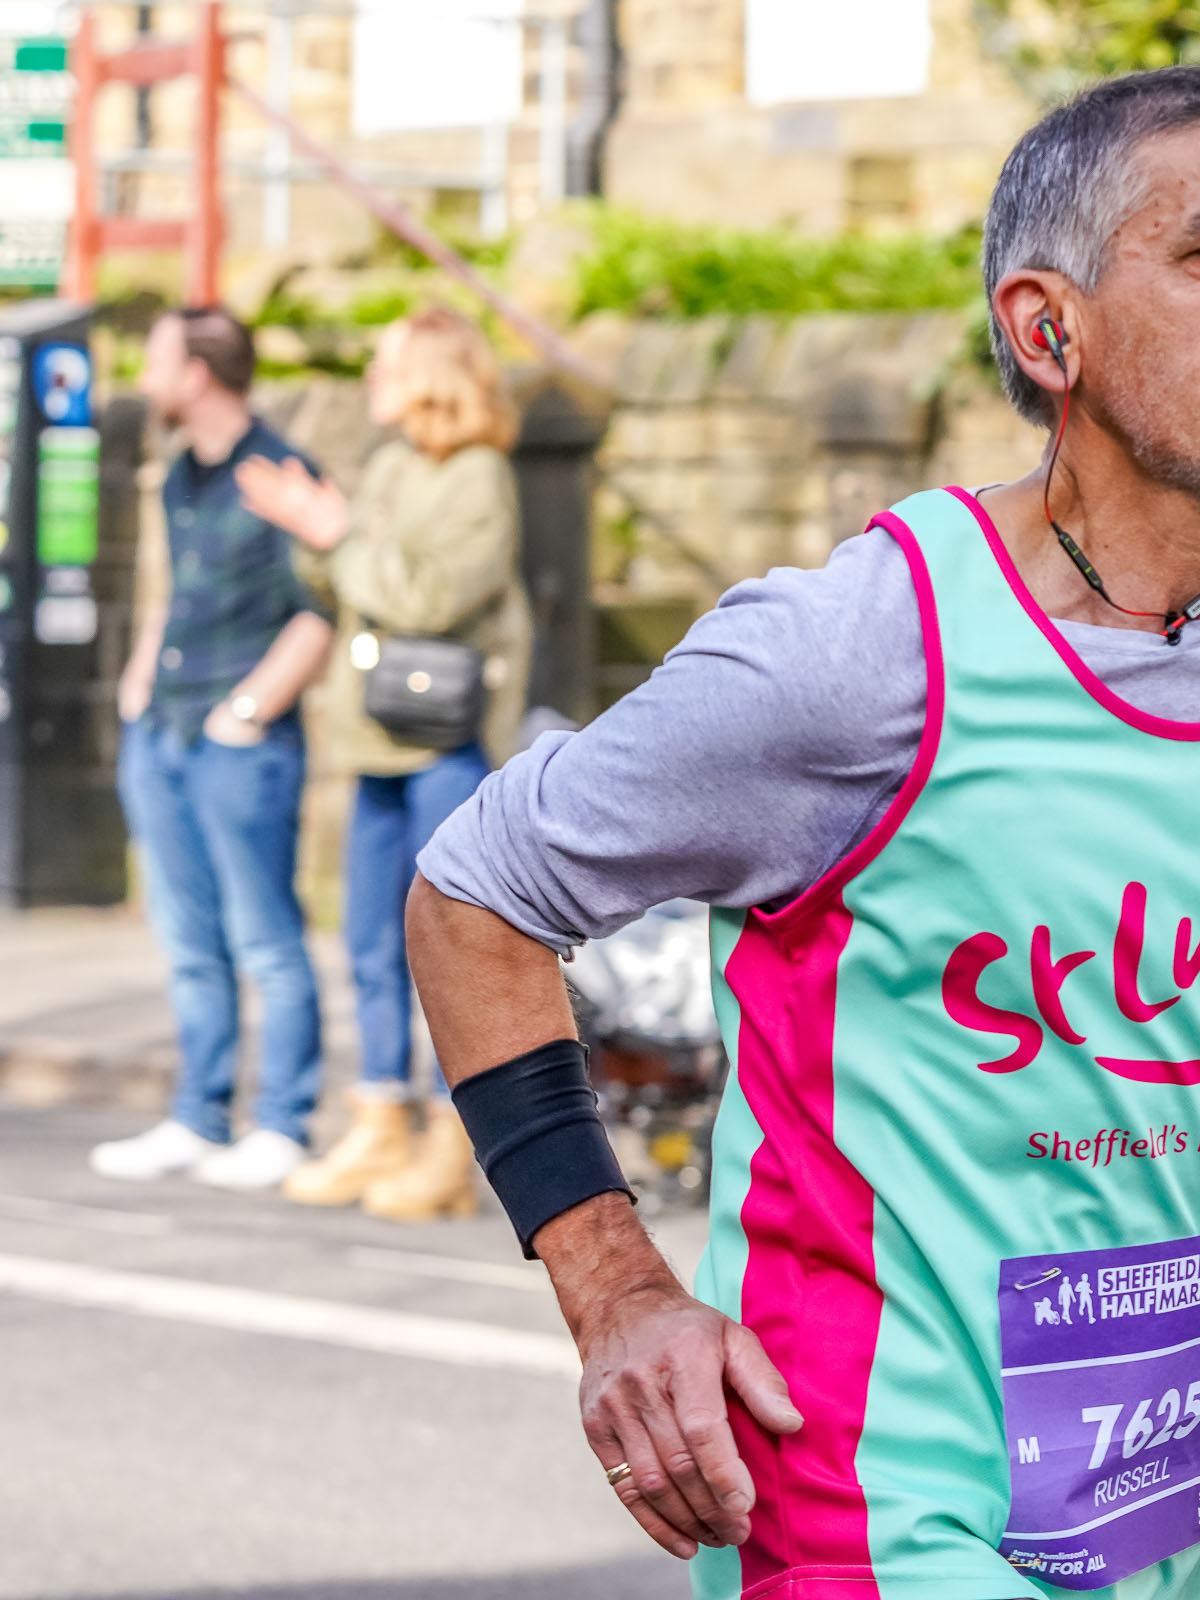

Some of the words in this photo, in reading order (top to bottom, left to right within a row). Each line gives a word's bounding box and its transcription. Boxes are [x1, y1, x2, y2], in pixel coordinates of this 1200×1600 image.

[942, 925, 1096, 1074] St
[1026, 1124, 1188, 1168] Sheffield's
[1102, 1258, 1196, 1293] SHEFFIELD
[1101, 1290, 1156, 1320] HALF
[1017, 1437, 1041, 1464] M
[1094, 1456, 1171, 1507] RUSSELL
[1049, 1561, 1084, 1575] FOR
[1086, 1554, 1107, 1573] ALL
